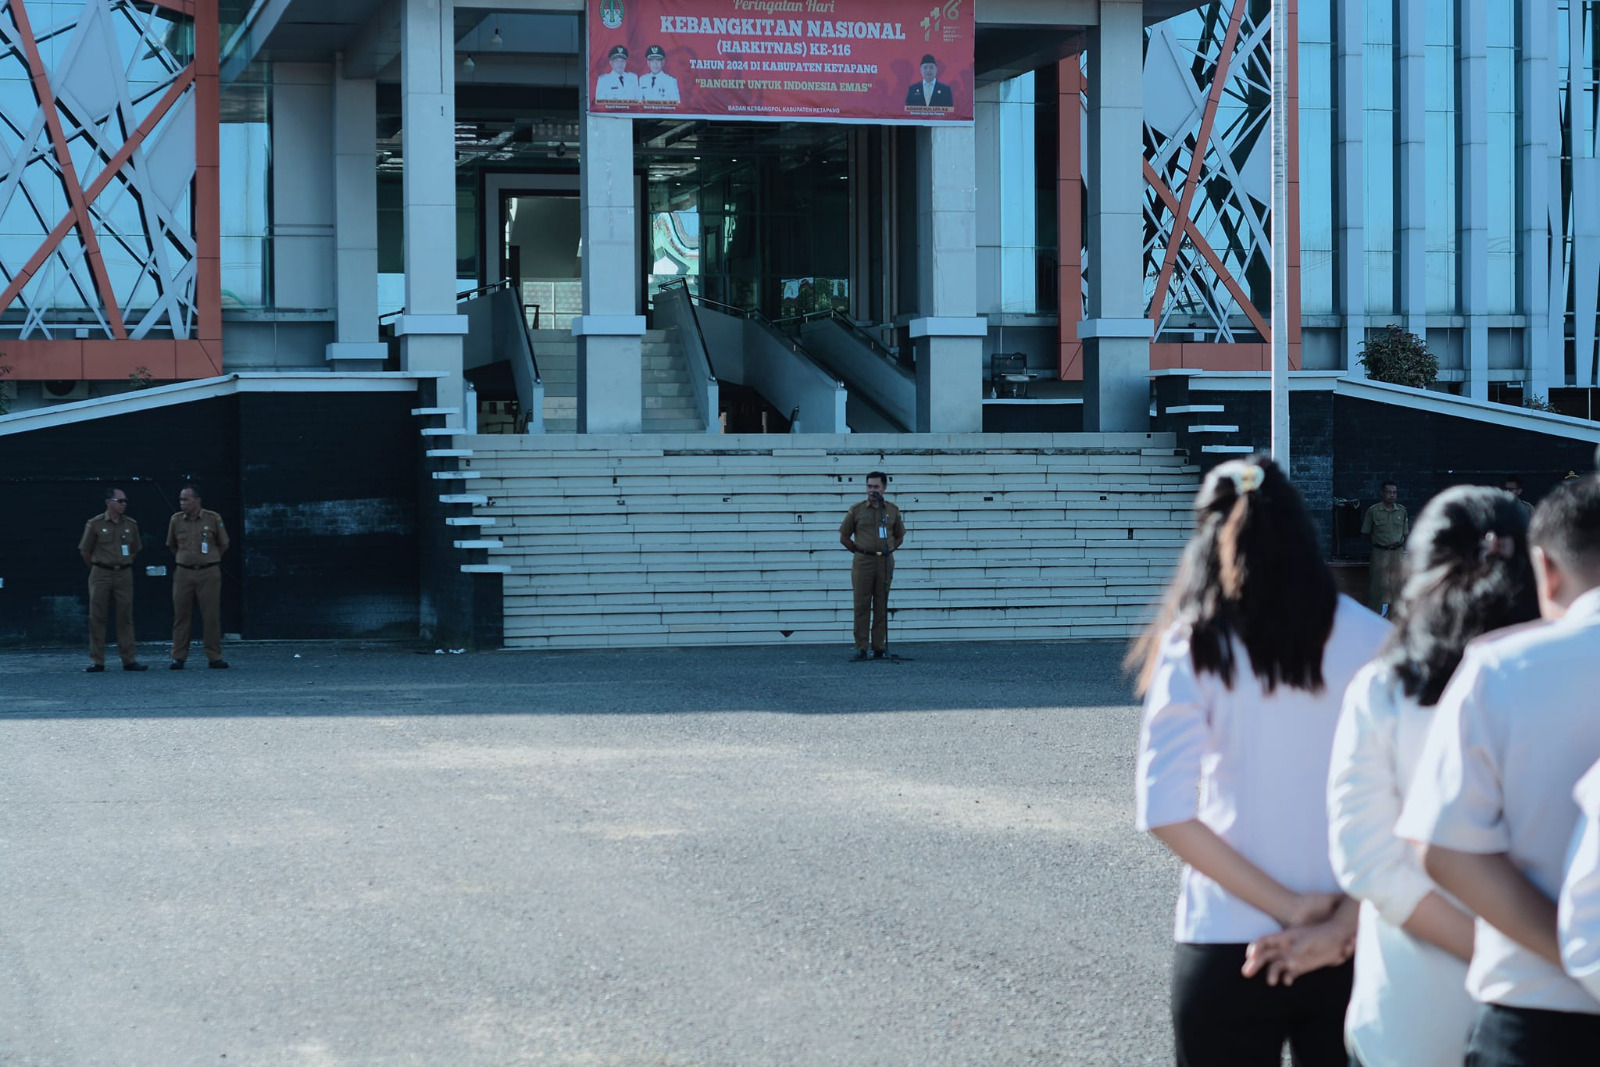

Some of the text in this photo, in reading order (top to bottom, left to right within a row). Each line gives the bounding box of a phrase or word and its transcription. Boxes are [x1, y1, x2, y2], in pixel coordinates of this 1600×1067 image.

[733, 0, 835, 14] Peringatan Hari
[660, 15, 906, 40] KEBANGKITAN NASIONAL
[716, 39, 851, 57] (HARKITNAS) KE-116
[689, 59, 878, 74] TAHUN 2024 DI KABUPATEN KETAPANG
[695, 78, 873, 92] "BANGKIT UNTUK INDONESIA EMAS"
